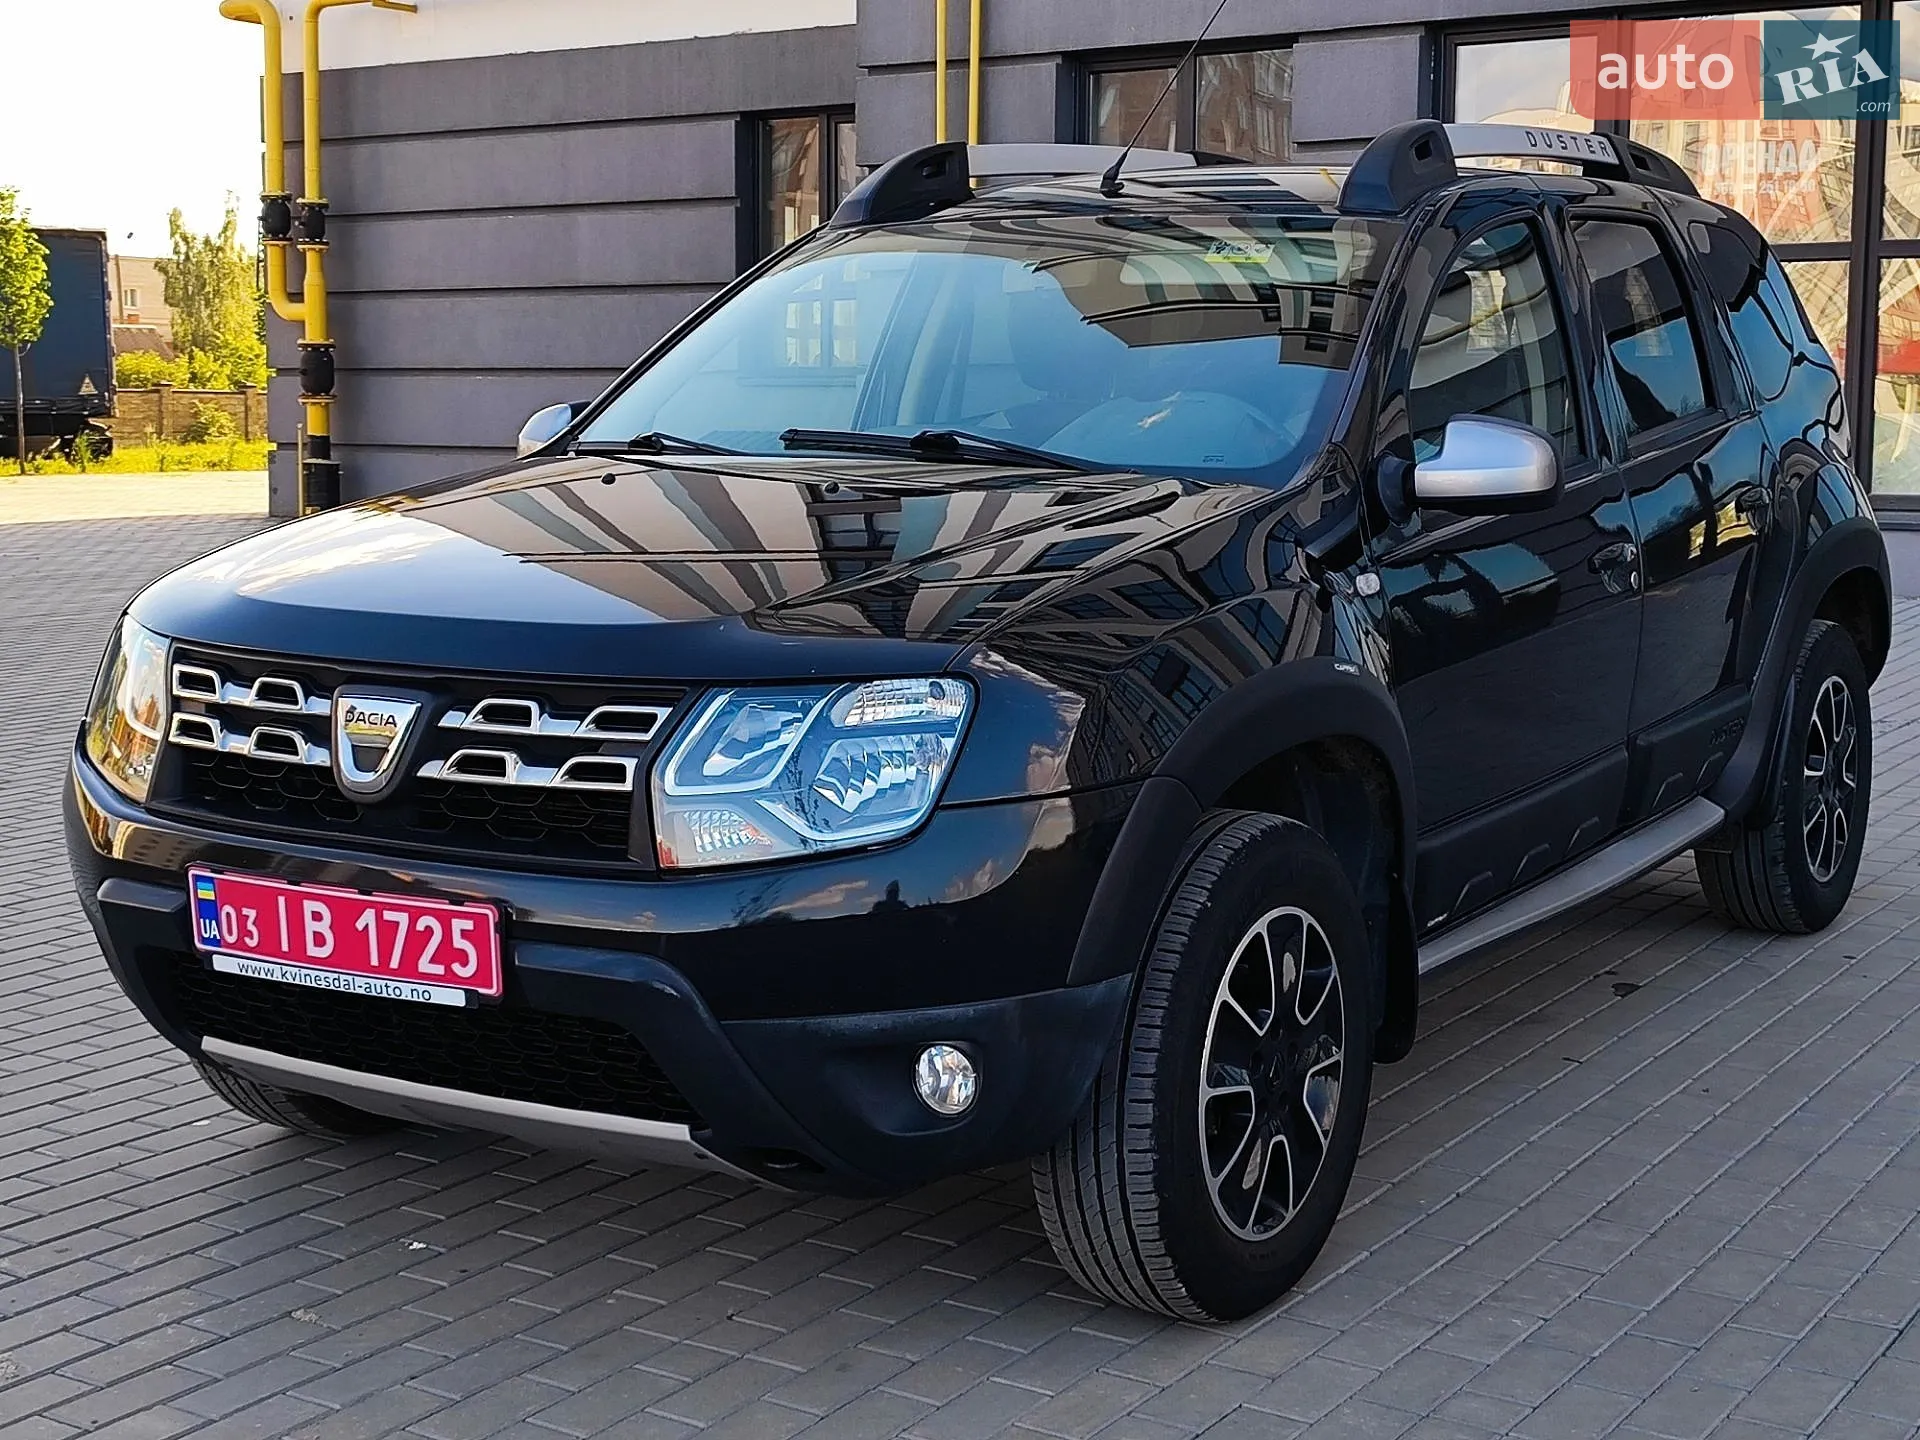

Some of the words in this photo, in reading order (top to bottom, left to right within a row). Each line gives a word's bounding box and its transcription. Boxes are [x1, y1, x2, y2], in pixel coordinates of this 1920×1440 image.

[1525, 130, 1611, 158] DUSTER
[1700, 139, 1818, 176] ОРЕНДА
[345, 710, 398, 728] DACIA
[200, 918, 221, 940] UA
[221, 904, 260, 948] 03
[355, 908, 478, 978] 1725
[237, 960, 432, 1002] www.kvinesdal-auto.no
